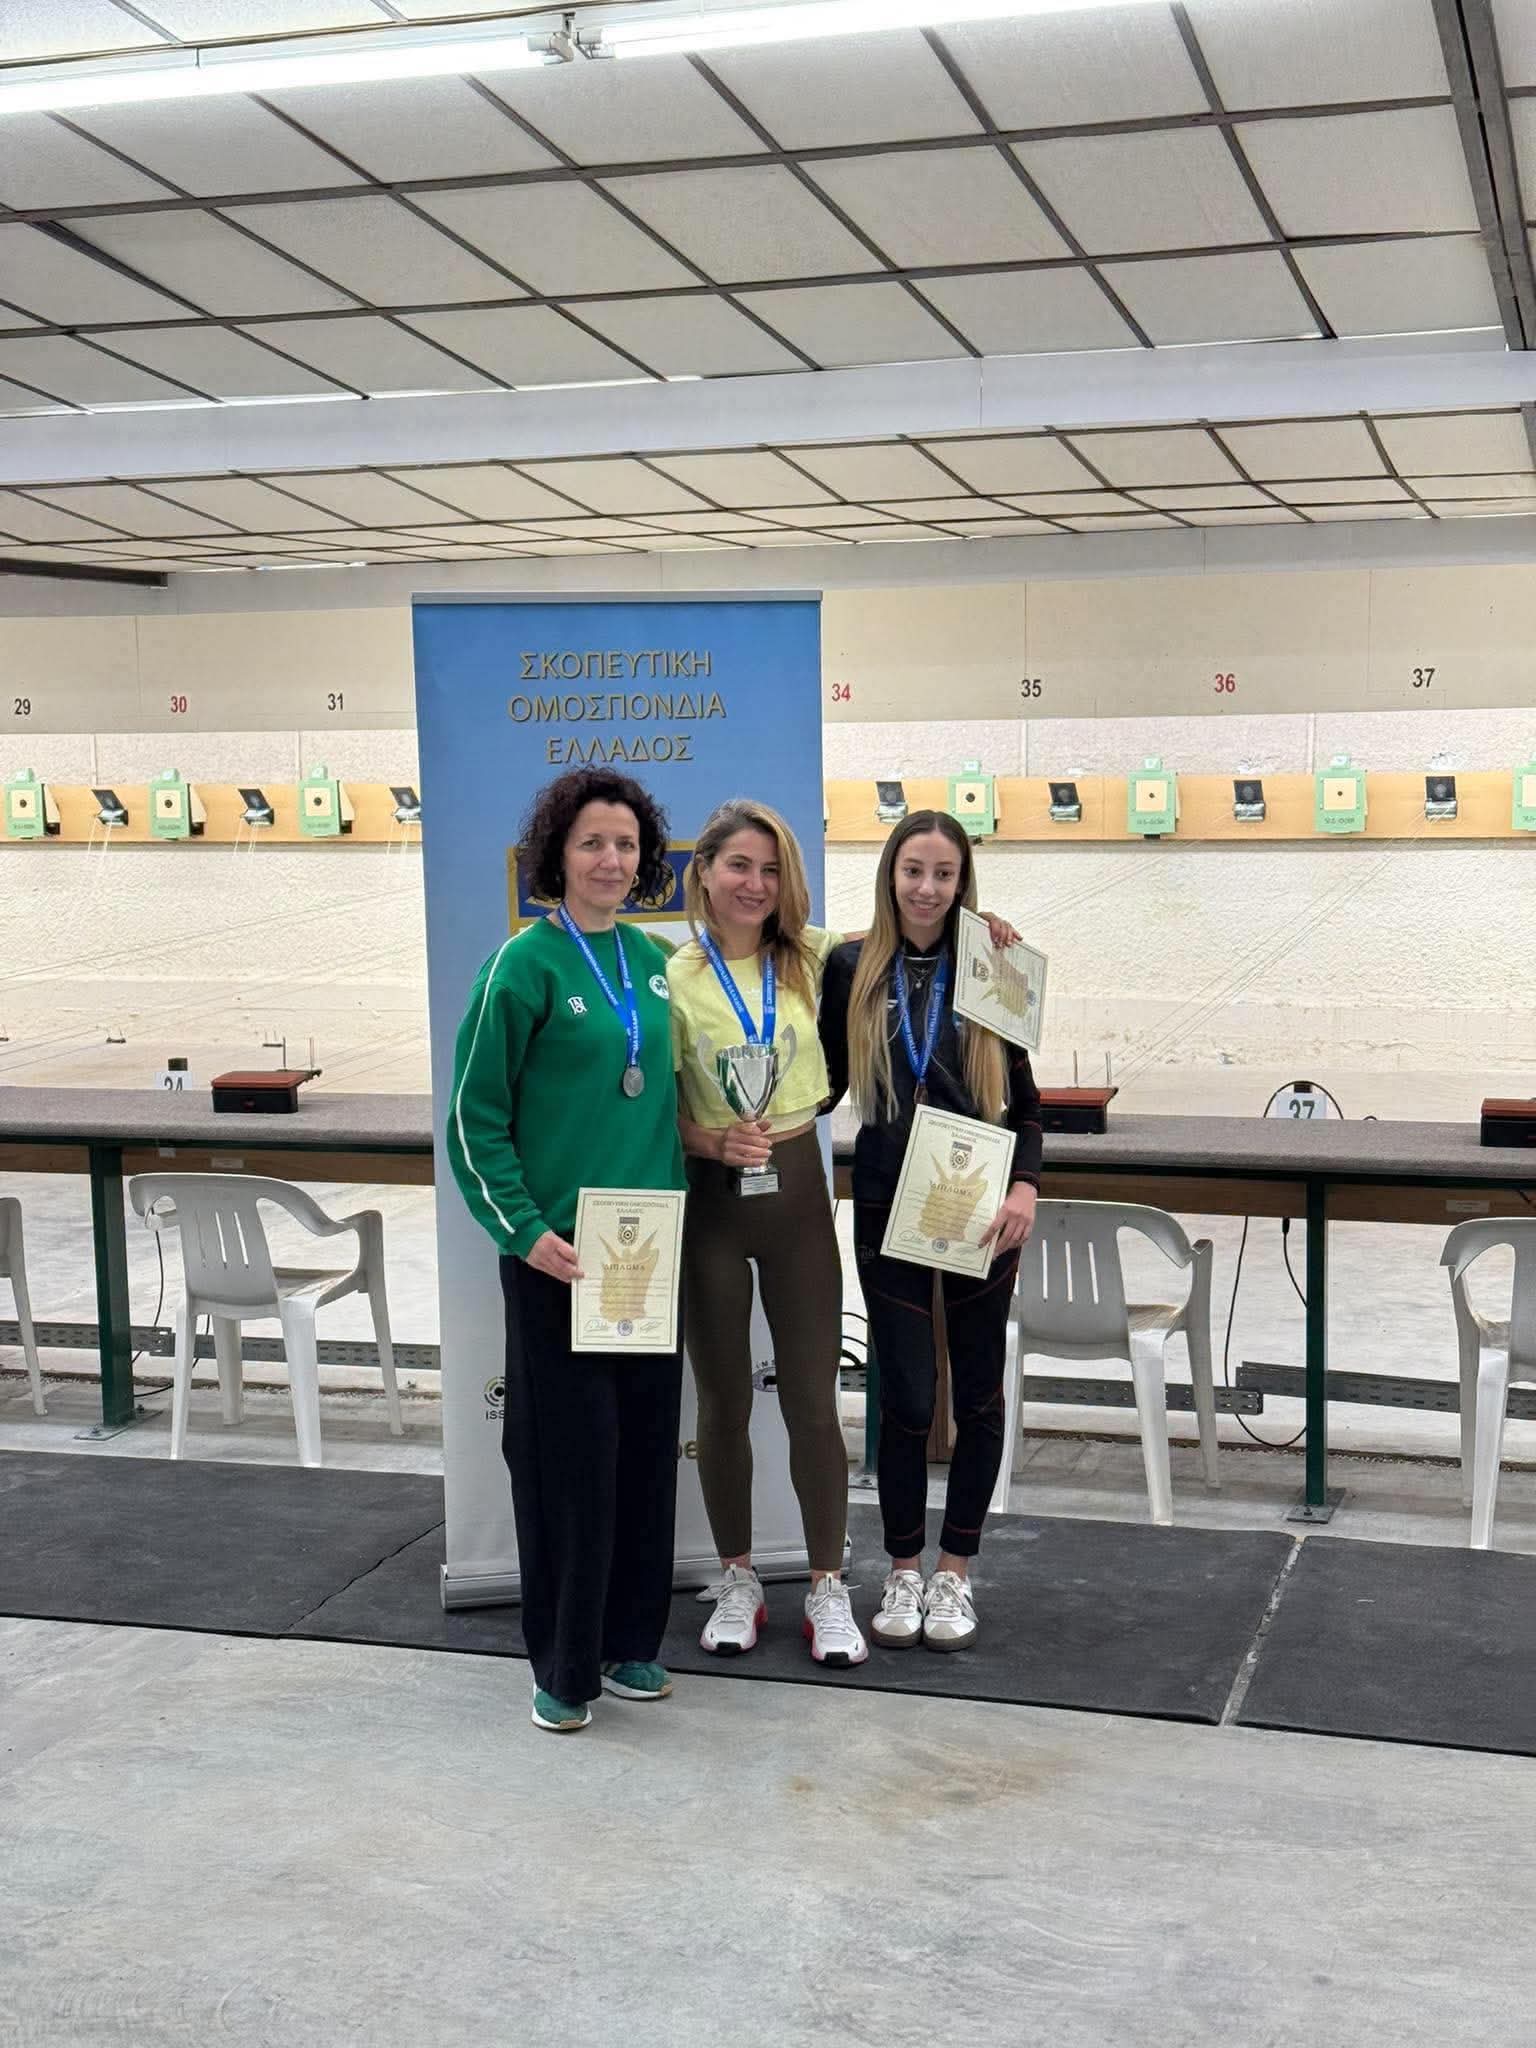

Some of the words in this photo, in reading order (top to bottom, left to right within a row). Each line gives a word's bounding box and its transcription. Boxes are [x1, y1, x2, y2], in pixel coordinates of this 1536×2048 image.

[519, 650, 712, 680] ΣΚΟΠΕΥΤΙΚΗ
[1214, 673, 1236, 693] 36
[1413, 668, 1435, 688] 37
[831, 683, 851, 702] 34
[1021, 679, 1042, 698] 35
[14, 698, 31, 716] 29
[170, 695, 188, 713] 30
[327, 693, 344, 711] 31
[507, 691, 727, 722] ΟΜΟΣΠΟΝΔΙΑ
[546, 734, 694, 763] ΕΛΛΑΔΟΣ
[486, 1410, 504, 1421] ISS
